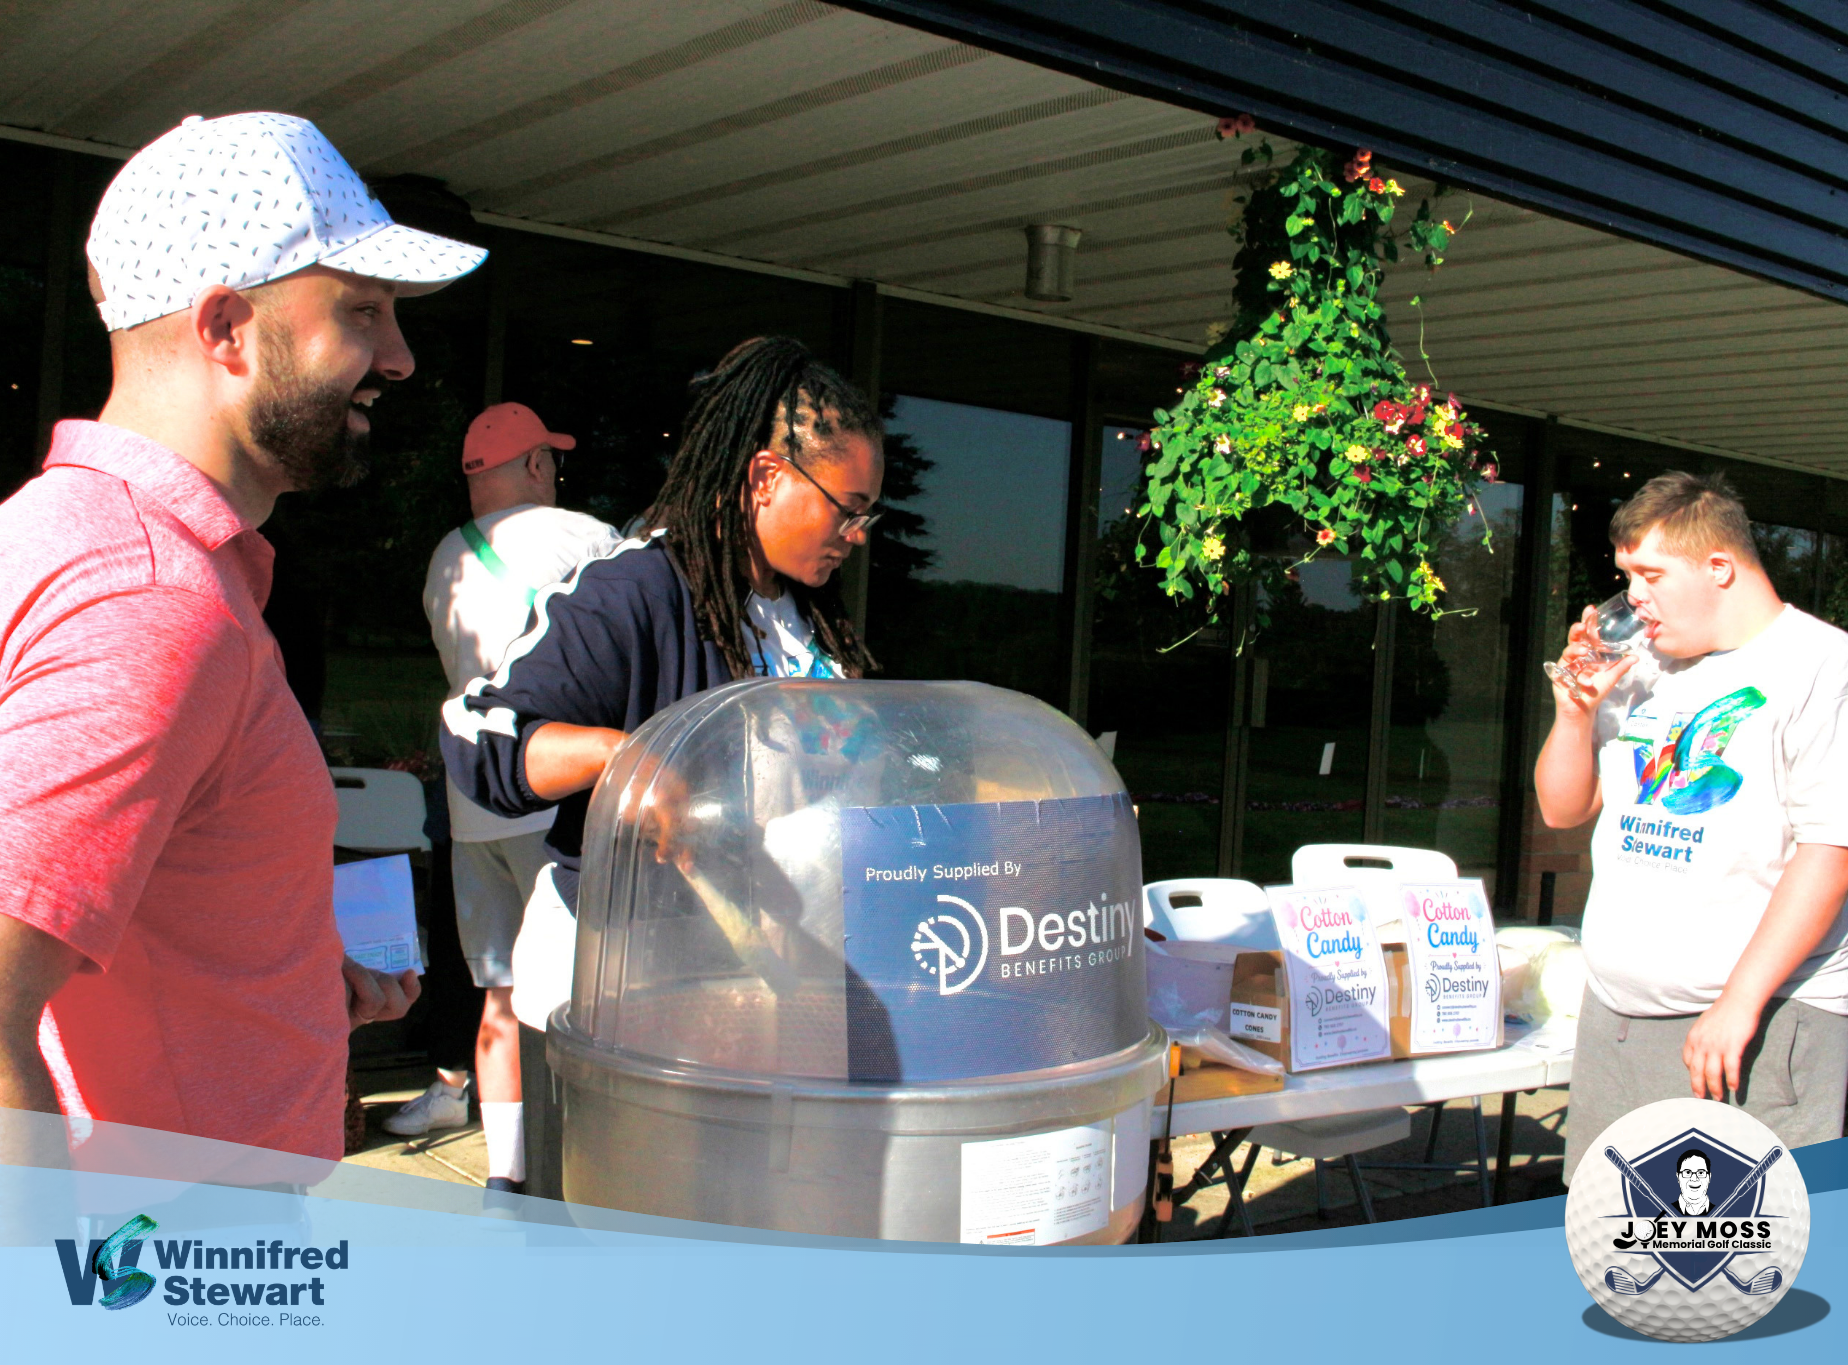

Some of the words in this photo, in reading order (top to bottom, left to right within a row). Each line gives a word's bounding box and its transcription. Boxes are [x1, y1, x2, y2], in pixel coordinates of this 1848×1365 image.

[865, 865, 928, 882] Proudly
[933, 861, 999, 881] Supplied
[1004, 861, 1022, 877] By
[1300, 906, 1353, 932] Cotton
[1422, 897, 1472, 922] Cotton
[999, 891, 1136, 957] Destiny
[1306, 930, 1364, 960] Candy
[1427, 922, 1480, 954] Candy
[1001, 954, 1083, 979] BENEFITS
[1088, 945, 1126, 967] GROUP
[1475, 961, 1482, 973] by
[1325, 983, 1377, 1006] Destiny
[1442, 975, 1489, 998] Destiny
[1232, 1008, 1256, 1018] COTTON
[1256, 1012, 1278, 1021] CANDY
[1244, 1024, 1264, 1034] CONES
